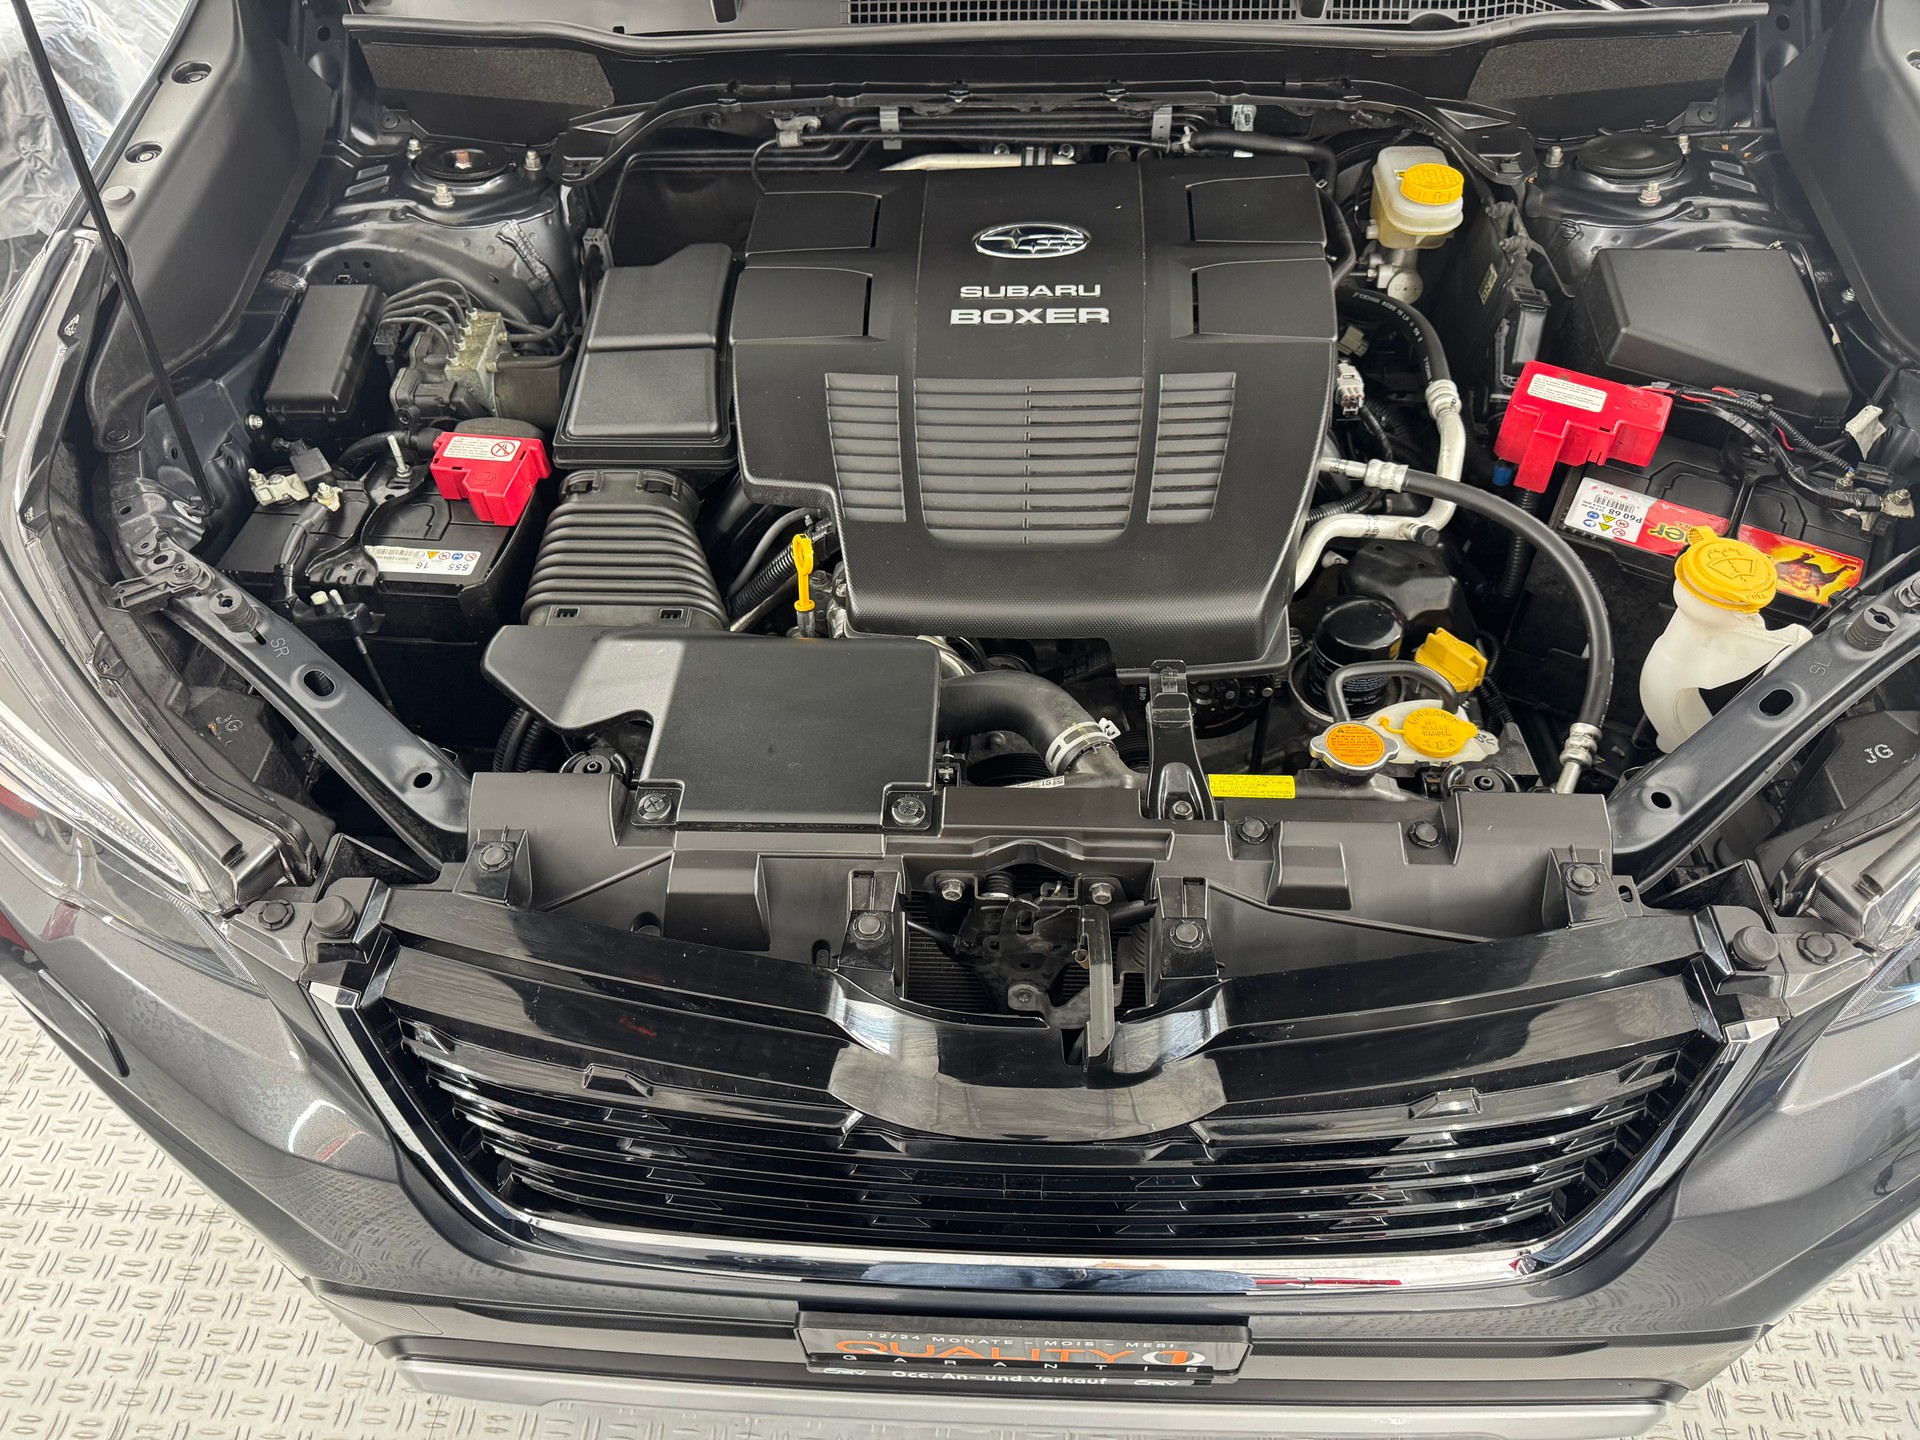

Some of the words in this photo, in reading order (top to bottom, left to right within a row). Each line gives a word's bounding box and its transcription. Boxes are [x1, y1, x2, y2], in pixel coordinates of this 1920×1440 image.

[960, 284, 1101, 299] SUBARU
[950, 307, 1110, 325] BOXER
[1608, 508, 1622, 517] 68
[1623, 512, 1643, 524] P60
[416, 562, 429, 570] 16
[448, 563, 470, 571] 555
[270, 637, 290, 658] SR
[1809, 659, 1833, 676] SL
[1863, 743, 1894, 764] JG
[867, 1332, 921, 1341] 12/24
[932, 1336, 1014, 1345] MONATE
[836, 1340, 1136, 1364] QUALITY
[891, 1370, 935, 1379] Occ.
[942, 1372, 977, 1381] An-
[985, 1374, 1023, 1383] und
[1029, 1376, 1108, 1386] Verkauf
